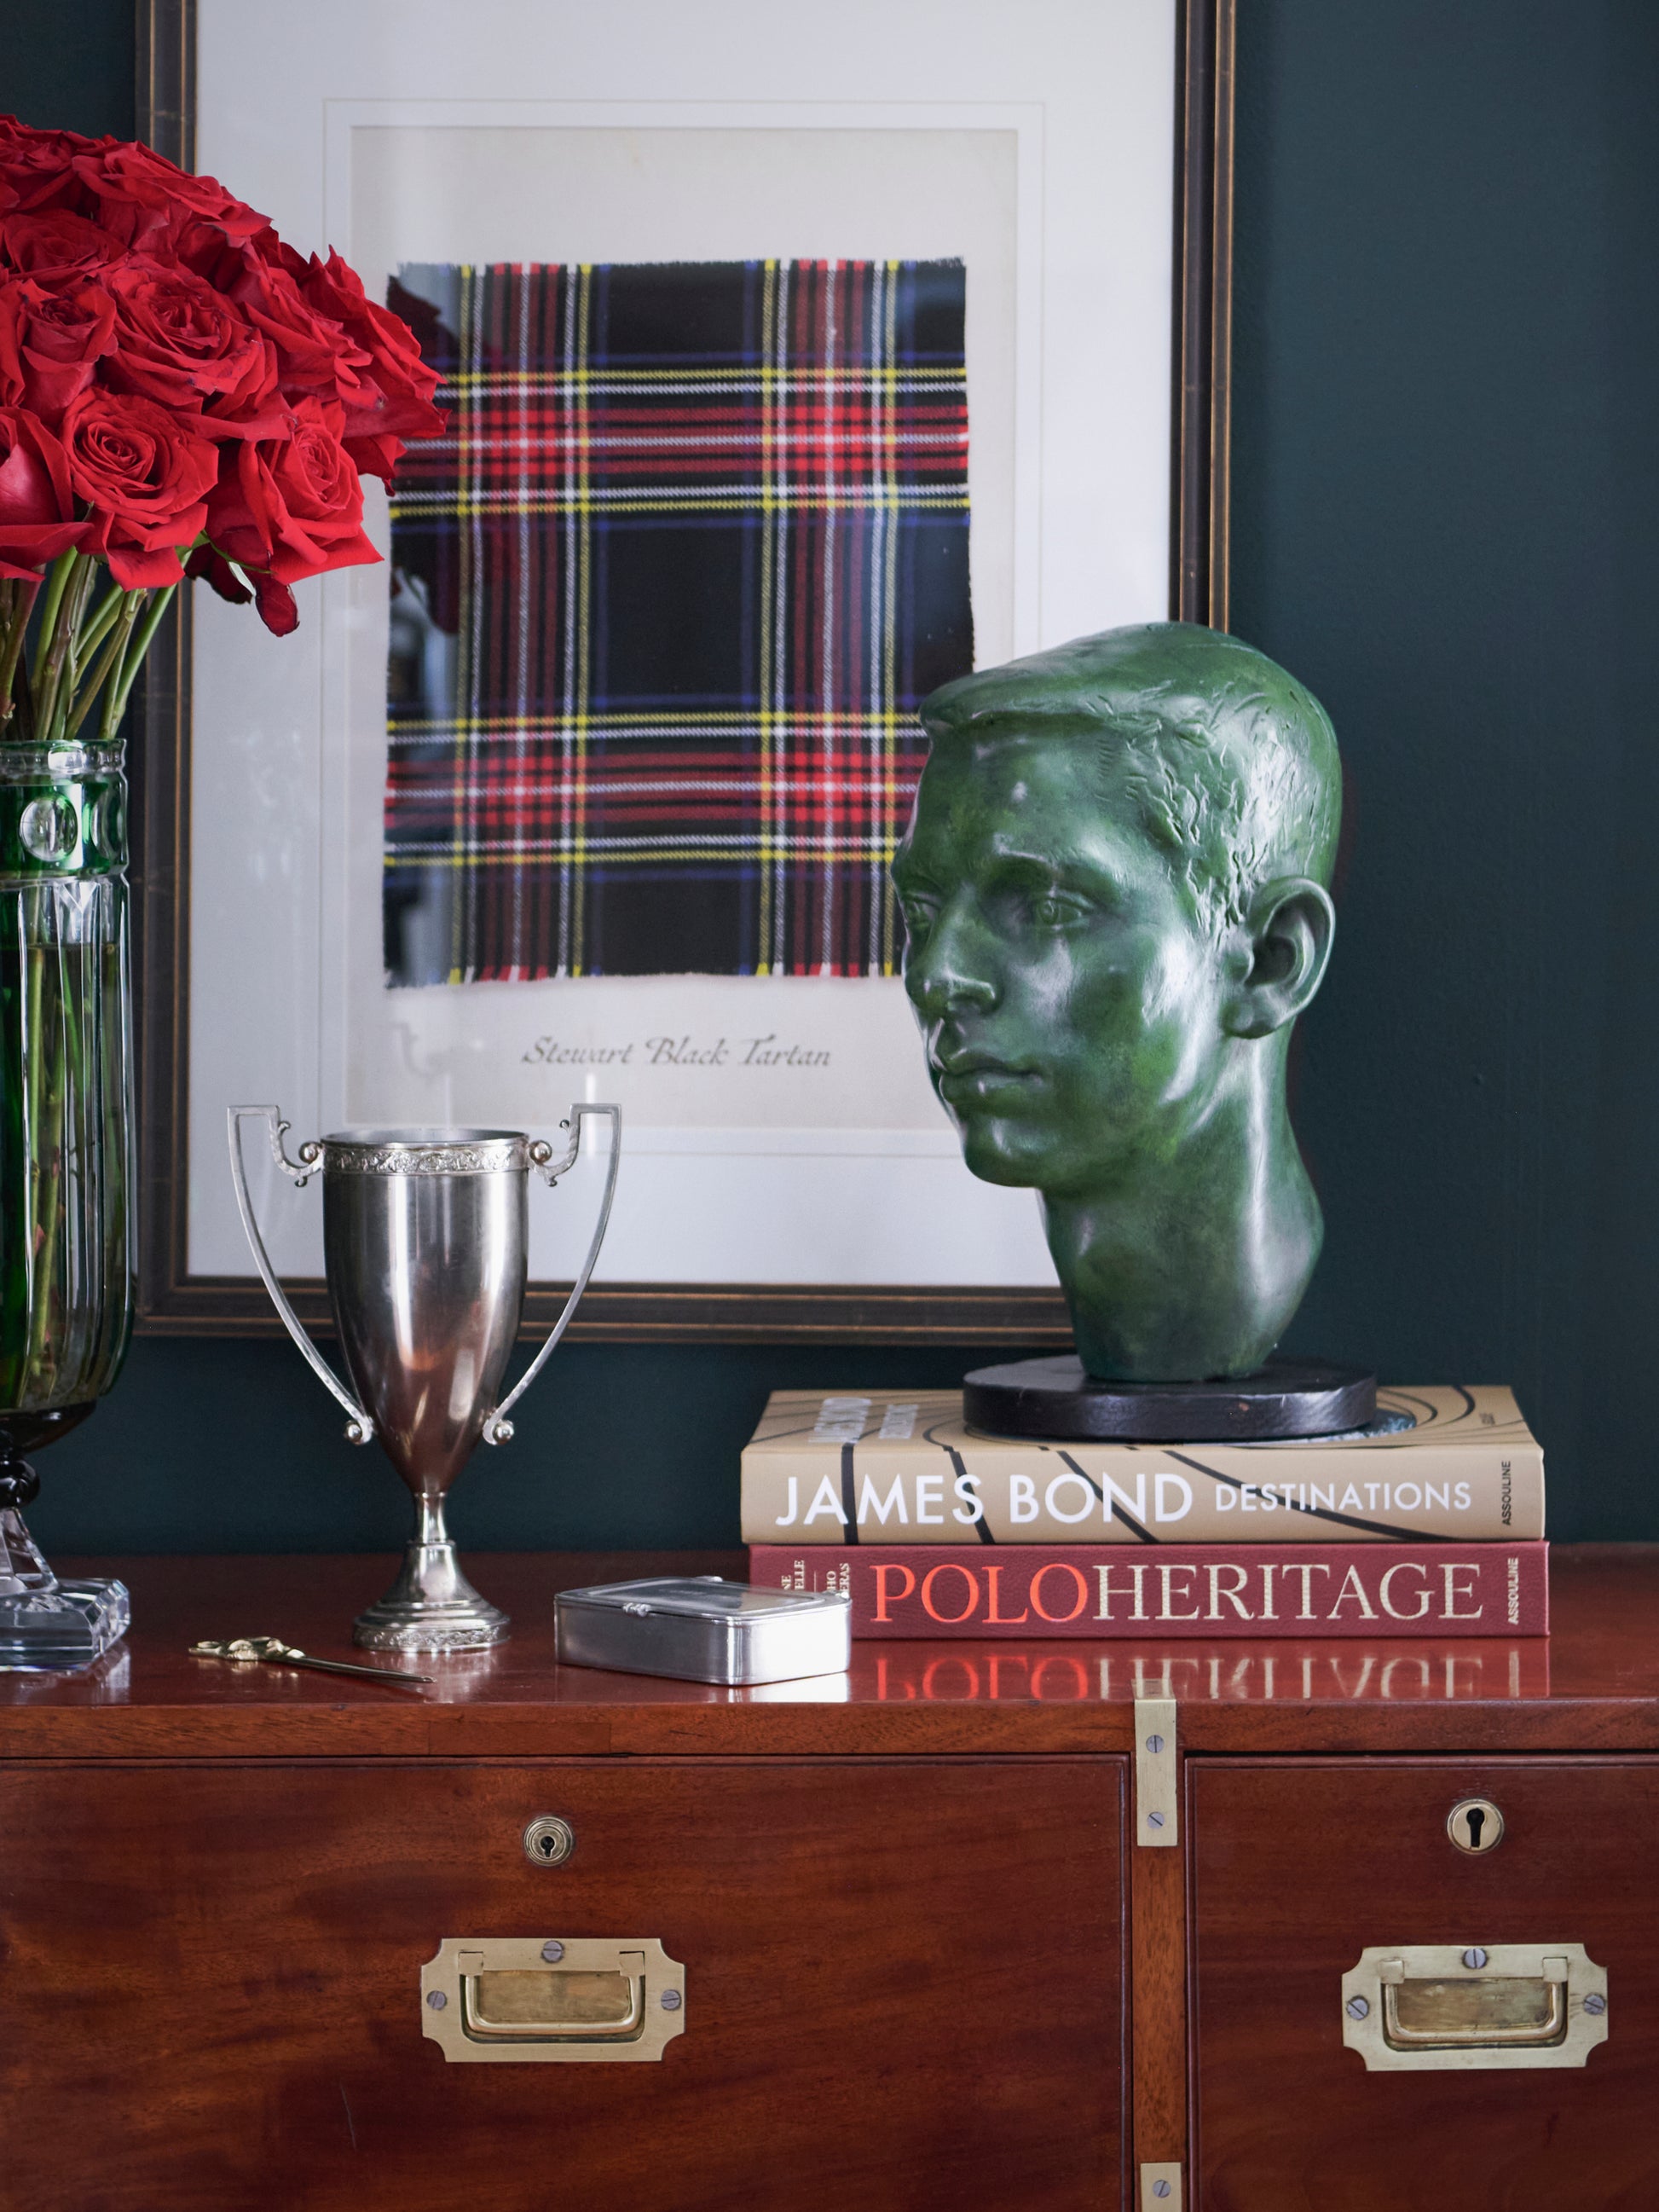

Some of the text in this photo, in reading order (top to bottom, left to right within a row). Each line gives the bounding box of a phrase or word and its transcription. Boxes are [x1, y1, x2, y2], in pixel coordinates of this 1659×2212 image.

[521, 1034, 831, 1066] Stewart Black Tartan
[775, 1473, 1471, 1525] JAMES BOND DESTINATIONS
[1501, 1461, 1512, 1526] ASSOULINE
[1507, 1557, 1519, 1625] ASSOULINE
